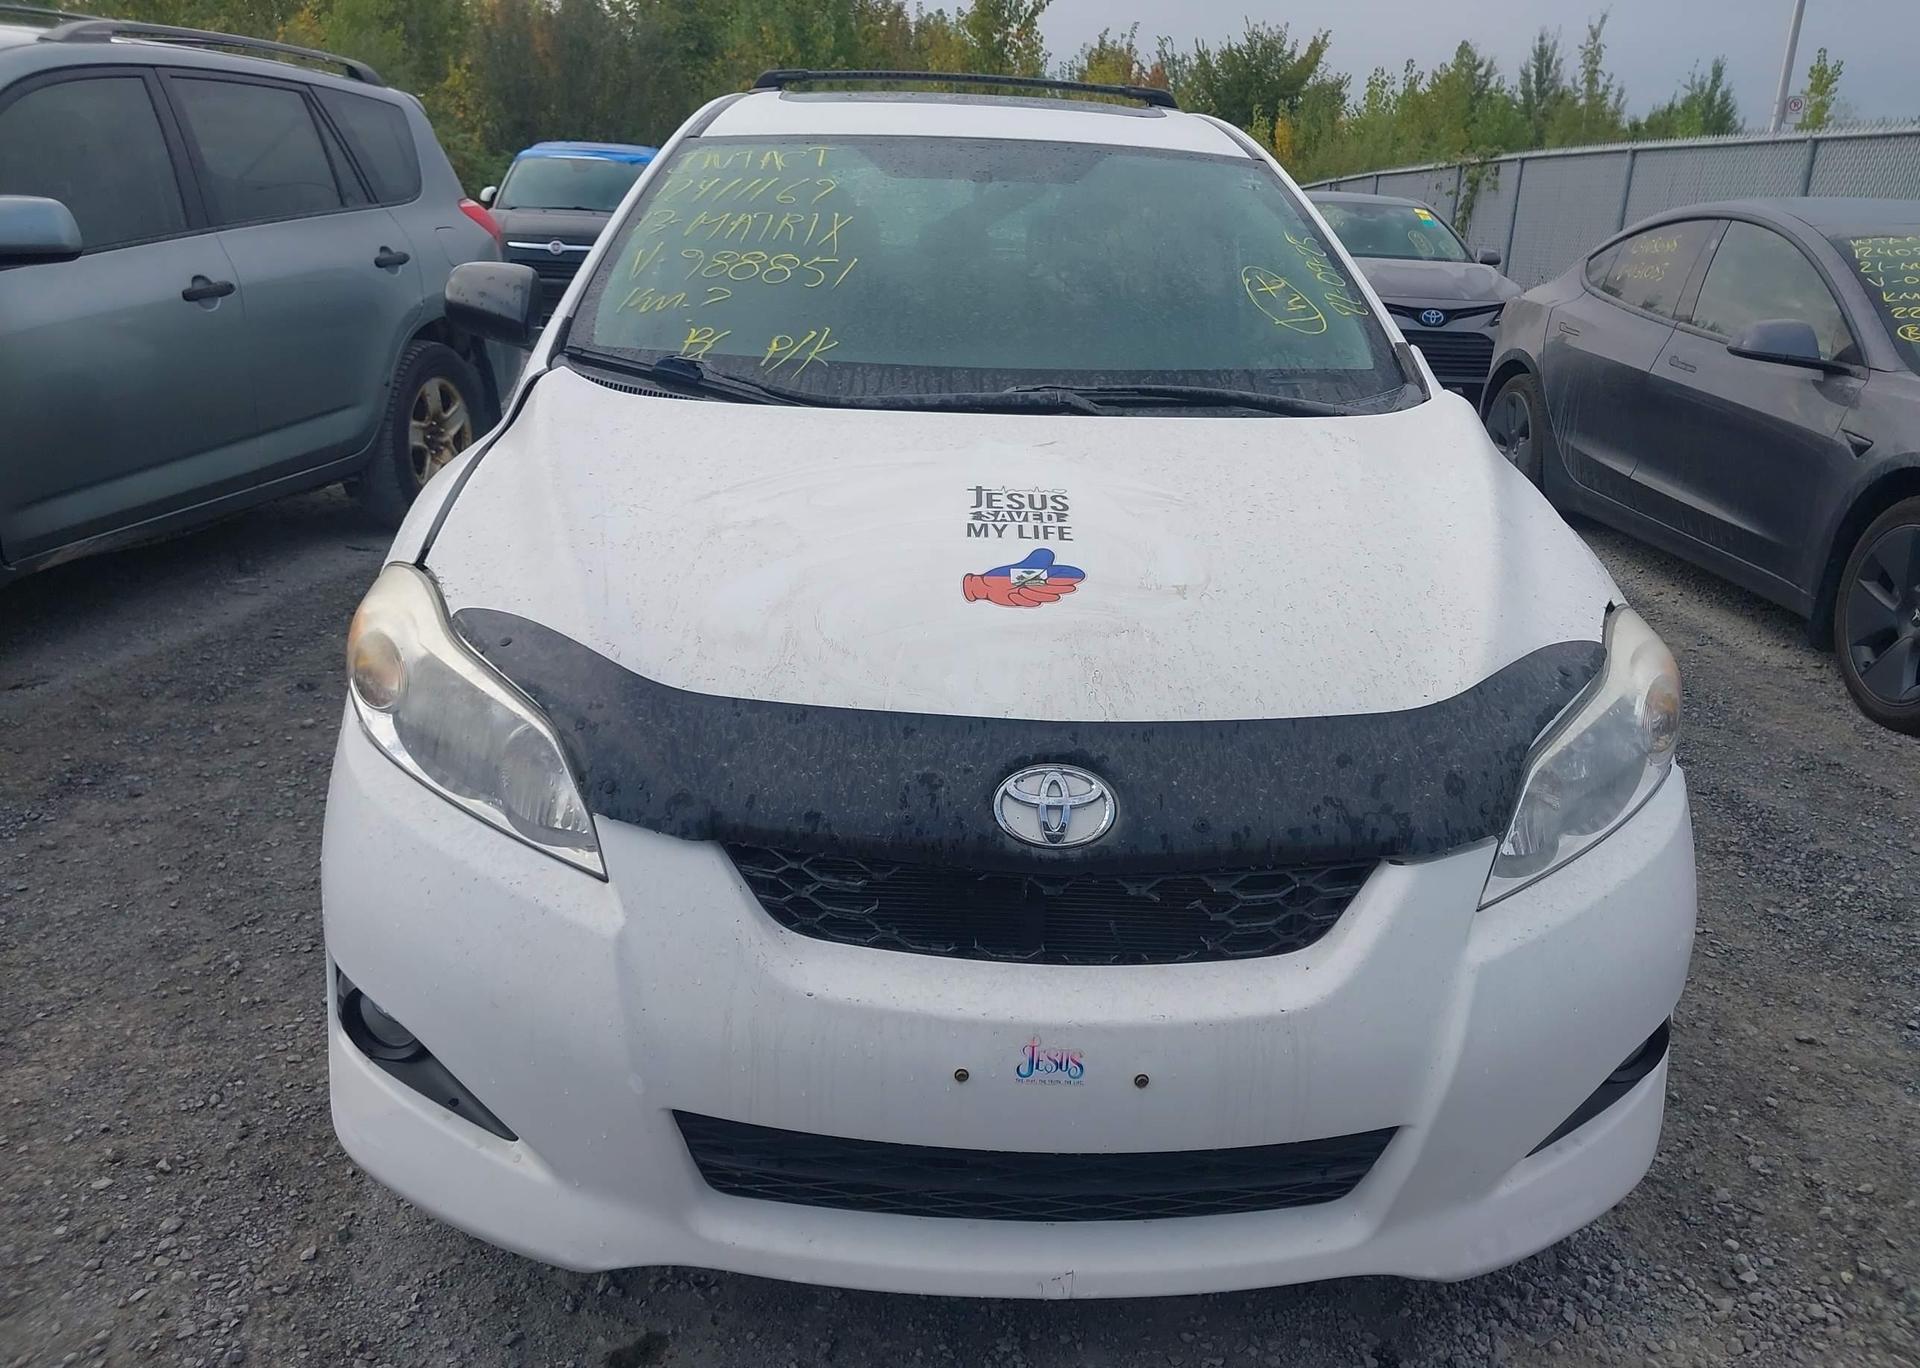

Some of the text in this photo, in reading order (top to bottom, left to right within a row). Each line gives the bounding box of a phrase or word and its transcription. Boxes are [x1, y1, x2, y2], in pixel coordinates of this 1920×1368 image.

[680, 248, 858, 289] 988851
[967, 485, 1070, 512] JESUS
[980, 511, 1058, 523] SAVED
[966, 522, 1074, 541] MY LIFE
[1016, 1036, 1085, 1079] JESUS
